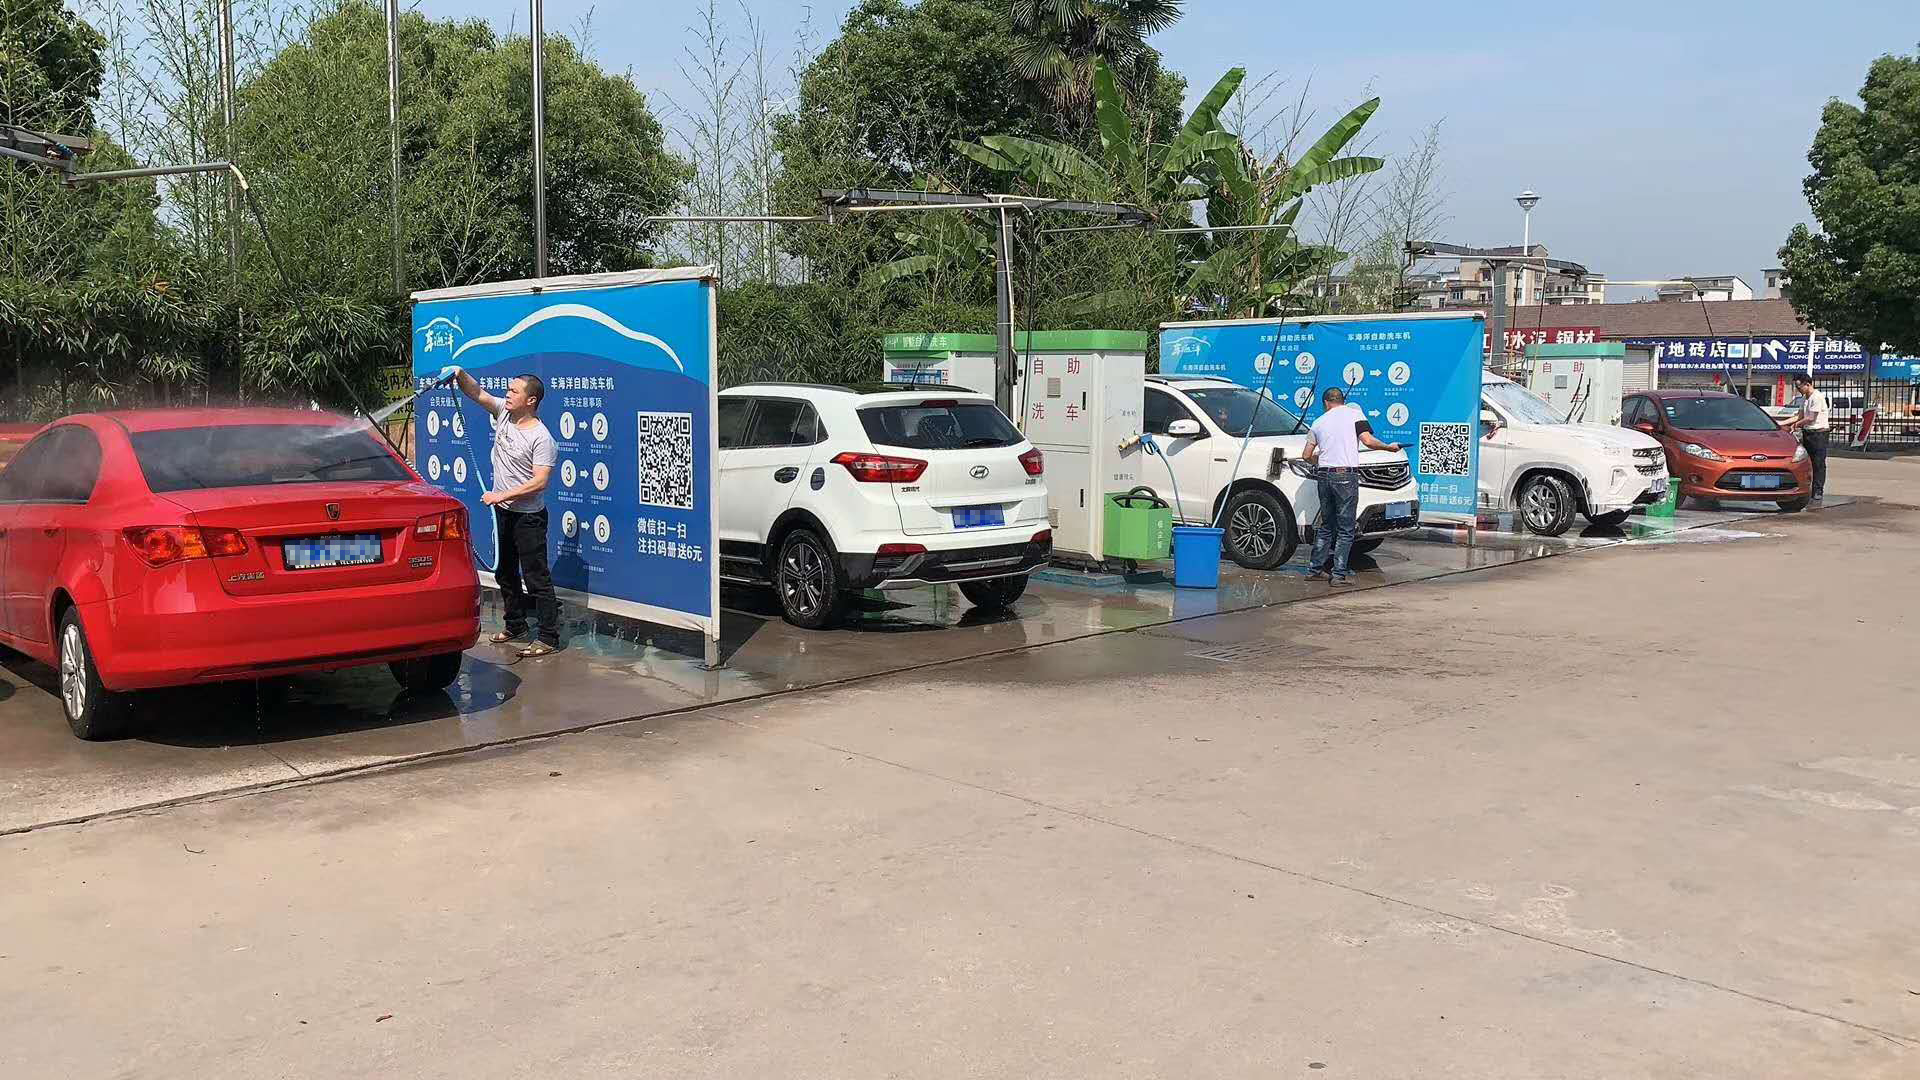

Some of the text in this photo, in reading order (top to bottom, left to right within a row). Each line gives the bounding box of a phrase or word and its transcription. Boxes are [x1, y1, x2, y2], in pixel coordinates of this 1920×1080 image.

[550, 376, 614, 390] 车海洋自助洗车机
[563, 397, 602, 408] 洗车注意事项
[1419, 494, 1473, 506] 扫码册送6元
[637, 517, 687, 539] 微信扫一扫
[637, 537, 703, 562] 注扫码册送6元
